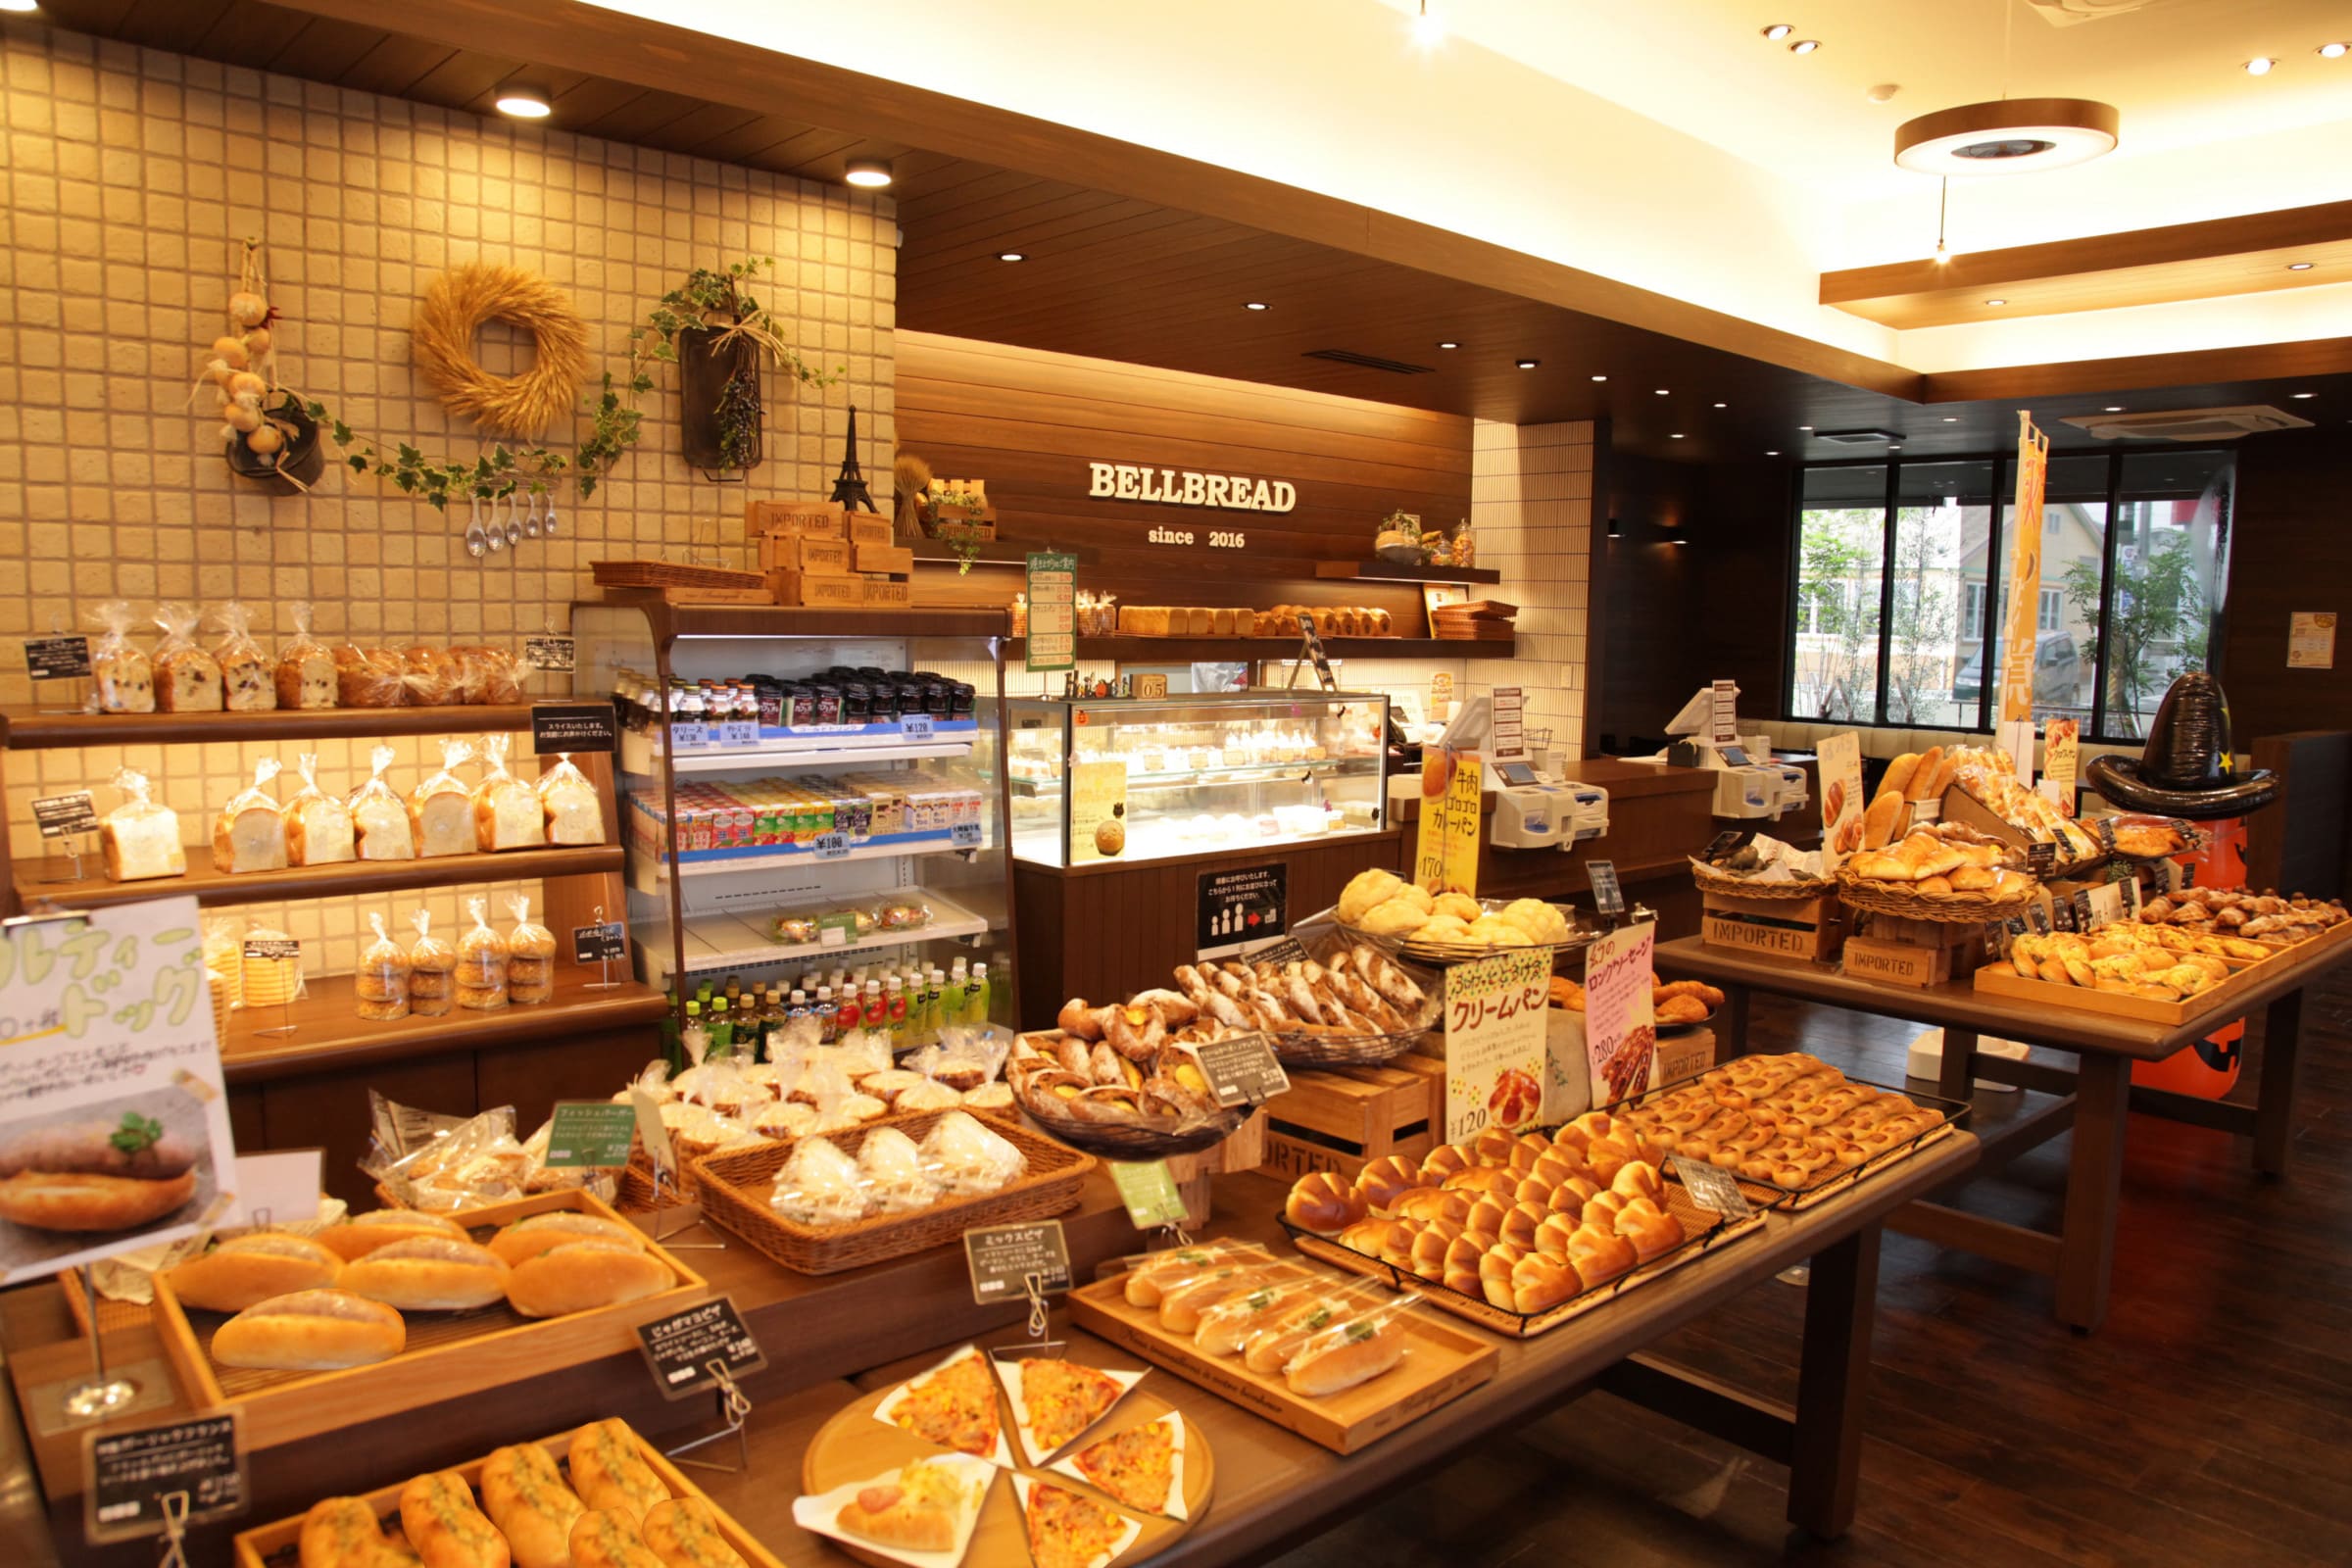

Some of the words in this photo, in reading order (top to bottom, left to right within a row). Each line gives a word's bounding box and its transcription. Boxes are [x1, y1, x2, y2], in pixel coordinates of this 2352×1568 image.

[1089, 463, 1297, 513] BELLBREAD
[770, 513, 829, 529] IMPORTED
[1148, 526, 1195, 545] since
[1208, 531, 1246, 548] 2016
[808, 548, 844, 564] IMPORTED
[814, 583, 852, 599] IMPORTED
[862, 582, 909, 603] IMPORTED
[1144, 683, 1163, 698] 05
[906, 721, 929, 734] ¥120
[1456, 767, 1479, 797] 牛肉
[1446, 795, 1478, 815] ゴロゴロ
[816, 836, 843, 851] ¥100
[1714, 921, 1804, 952] IMPORTED
[0, 920, 195, 990] ルティー
[1589, 939, 1616, 969] 幻の
[1853, 952, 1914, 976] IMPORTED
[62, 947, 203, 1039] ドッグ
[1451, 987, 1549, 1033] クリームパン
[1662, 1051, 1707, 1079] IMPORTED
[985, 1229, 1044, 1246] ミックスピザ
